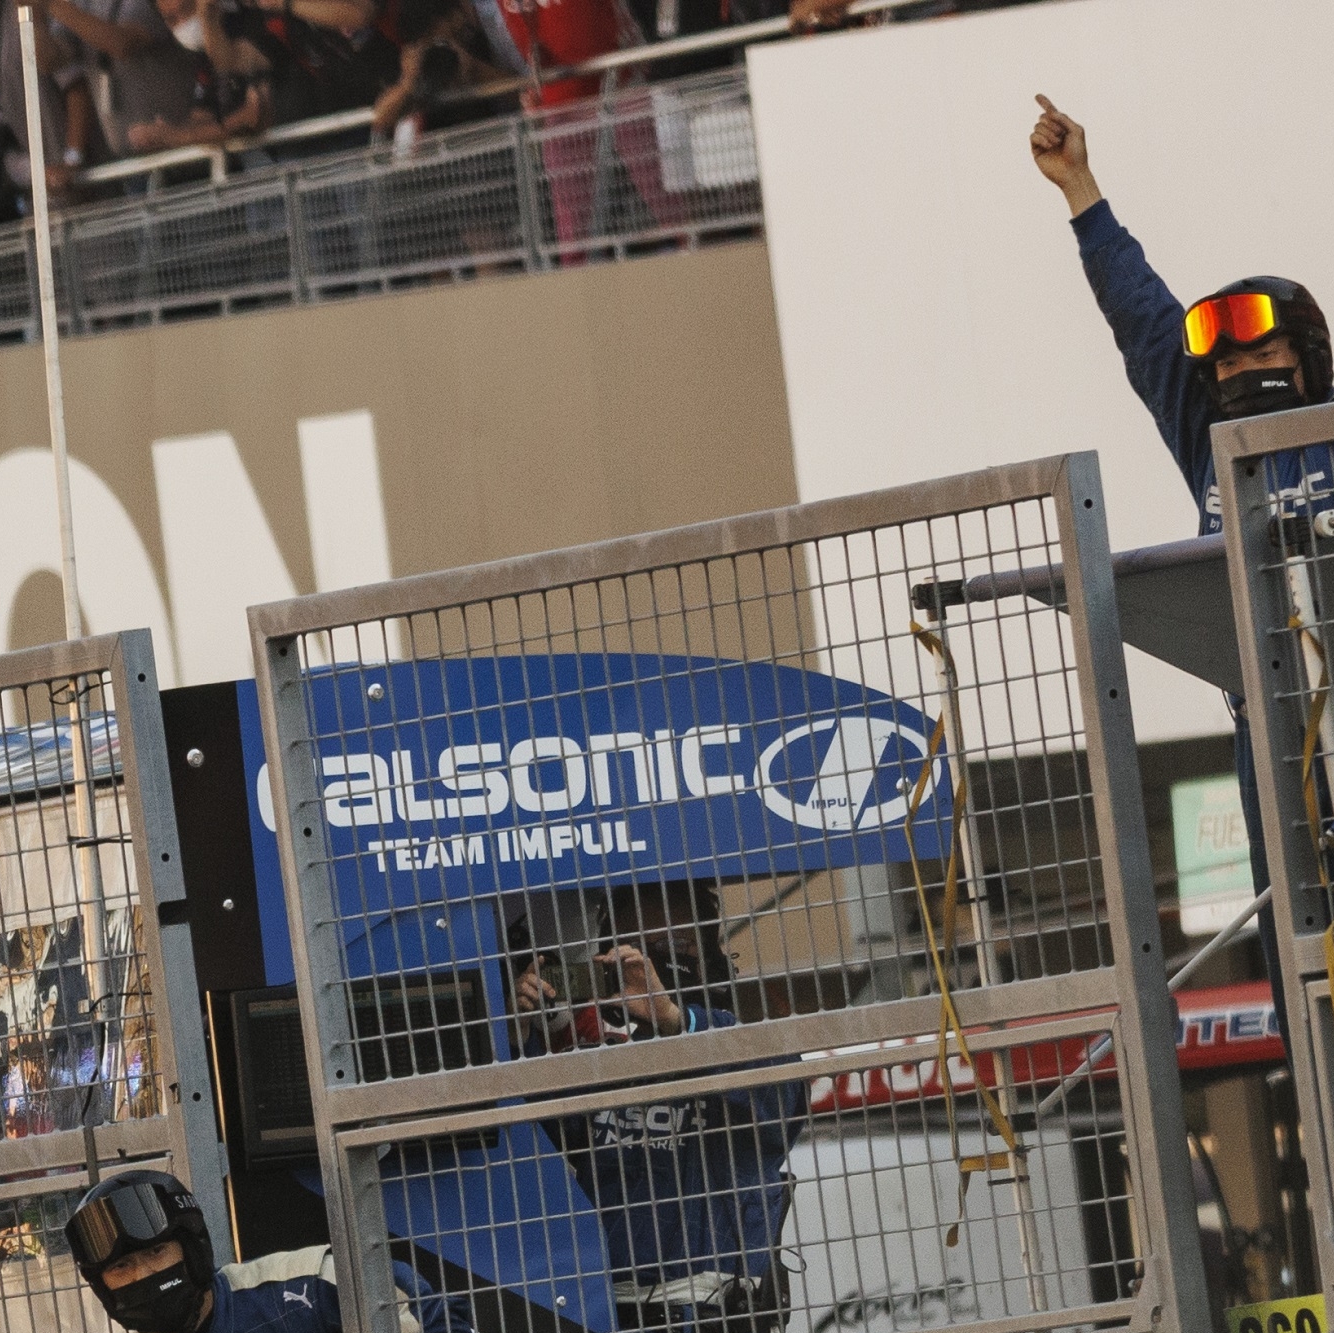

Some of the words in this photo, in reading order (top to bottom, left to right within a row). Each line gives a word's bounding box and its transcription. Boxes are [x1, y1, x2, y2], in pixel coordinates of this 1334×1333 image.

[368, 831, 485, 874] TEAM
[497, 820, 647, 864] IMPUL
[158, 1276, 183, 1292] IMPUL
